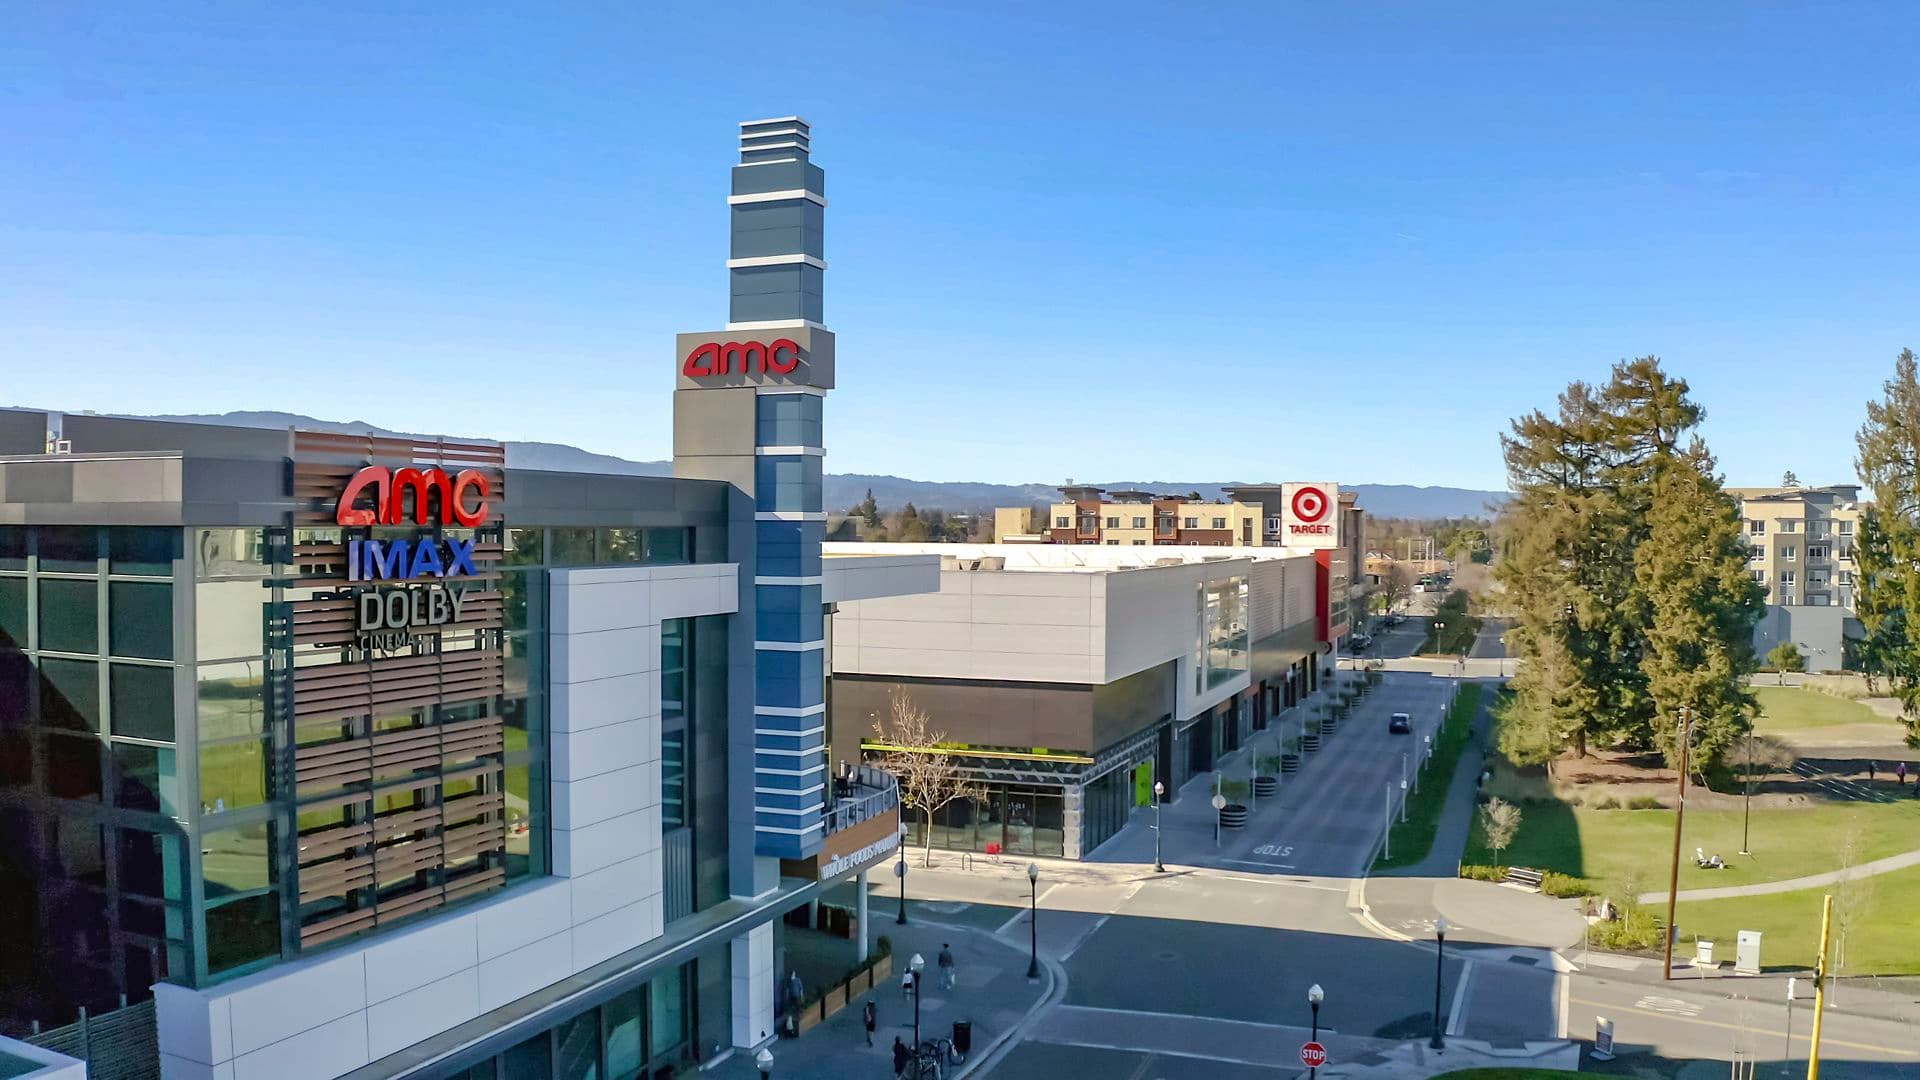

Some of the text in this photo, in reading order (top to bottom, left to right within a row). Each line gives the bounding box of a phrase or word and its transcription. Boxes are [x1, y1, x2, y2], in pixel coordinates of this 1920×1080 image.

[1289, 525, 1330, 534] TARGET
[349, 539, 478, 581] IMAX
[361, 587, 467, 631] DOLBY
[361, 631, 416, 651] CINEMA
[850, 846, 874, 868] FOODS
[1253, 845, 1294, 857] STOP
[1302, 1049, 1325, 1060] STOP
